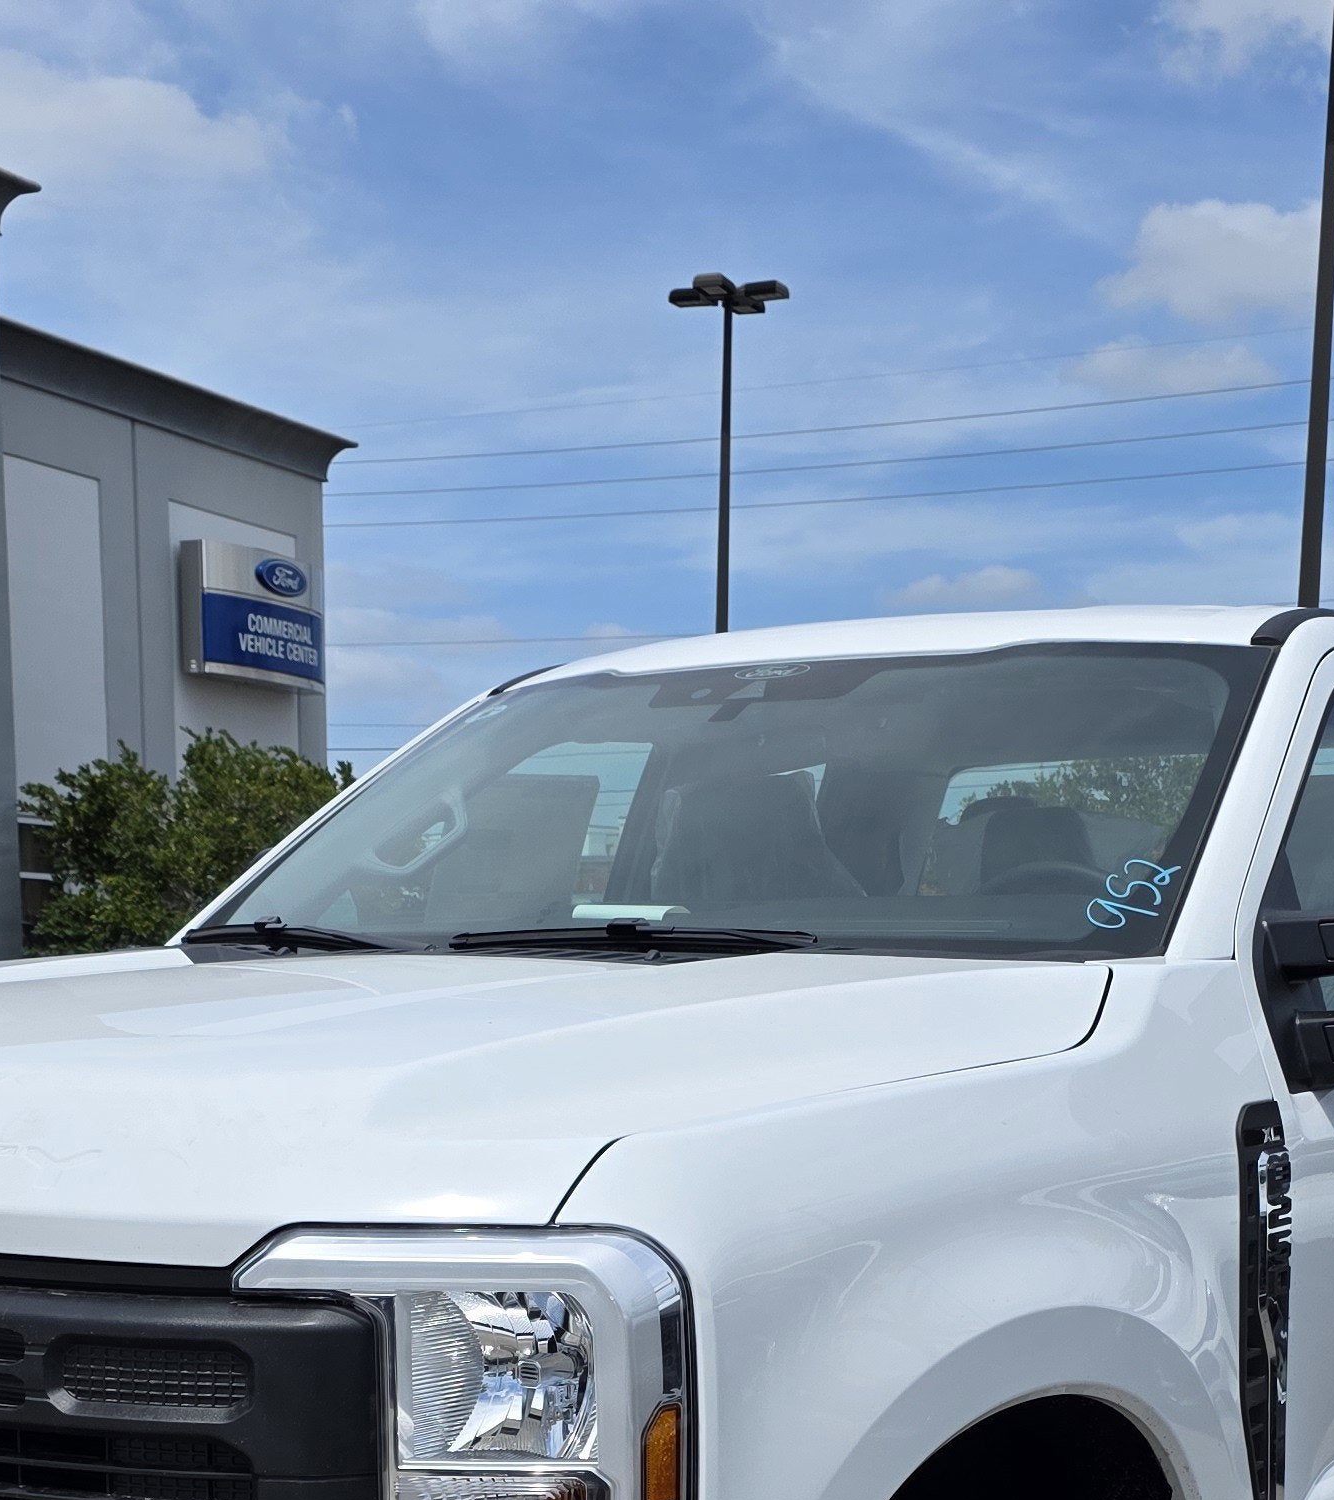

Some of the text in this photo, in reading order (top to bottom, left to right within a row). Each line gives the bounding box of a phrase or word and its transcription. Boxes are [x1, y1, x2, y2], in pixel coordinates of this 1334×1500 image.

[272, 567, 301, 590] Ford
[247, 613, 313, 645] COMMERCIAL
[238, 632, 318, 667] VEHICLE CENTER
[1262, 1126, 1280, 1143] XL
